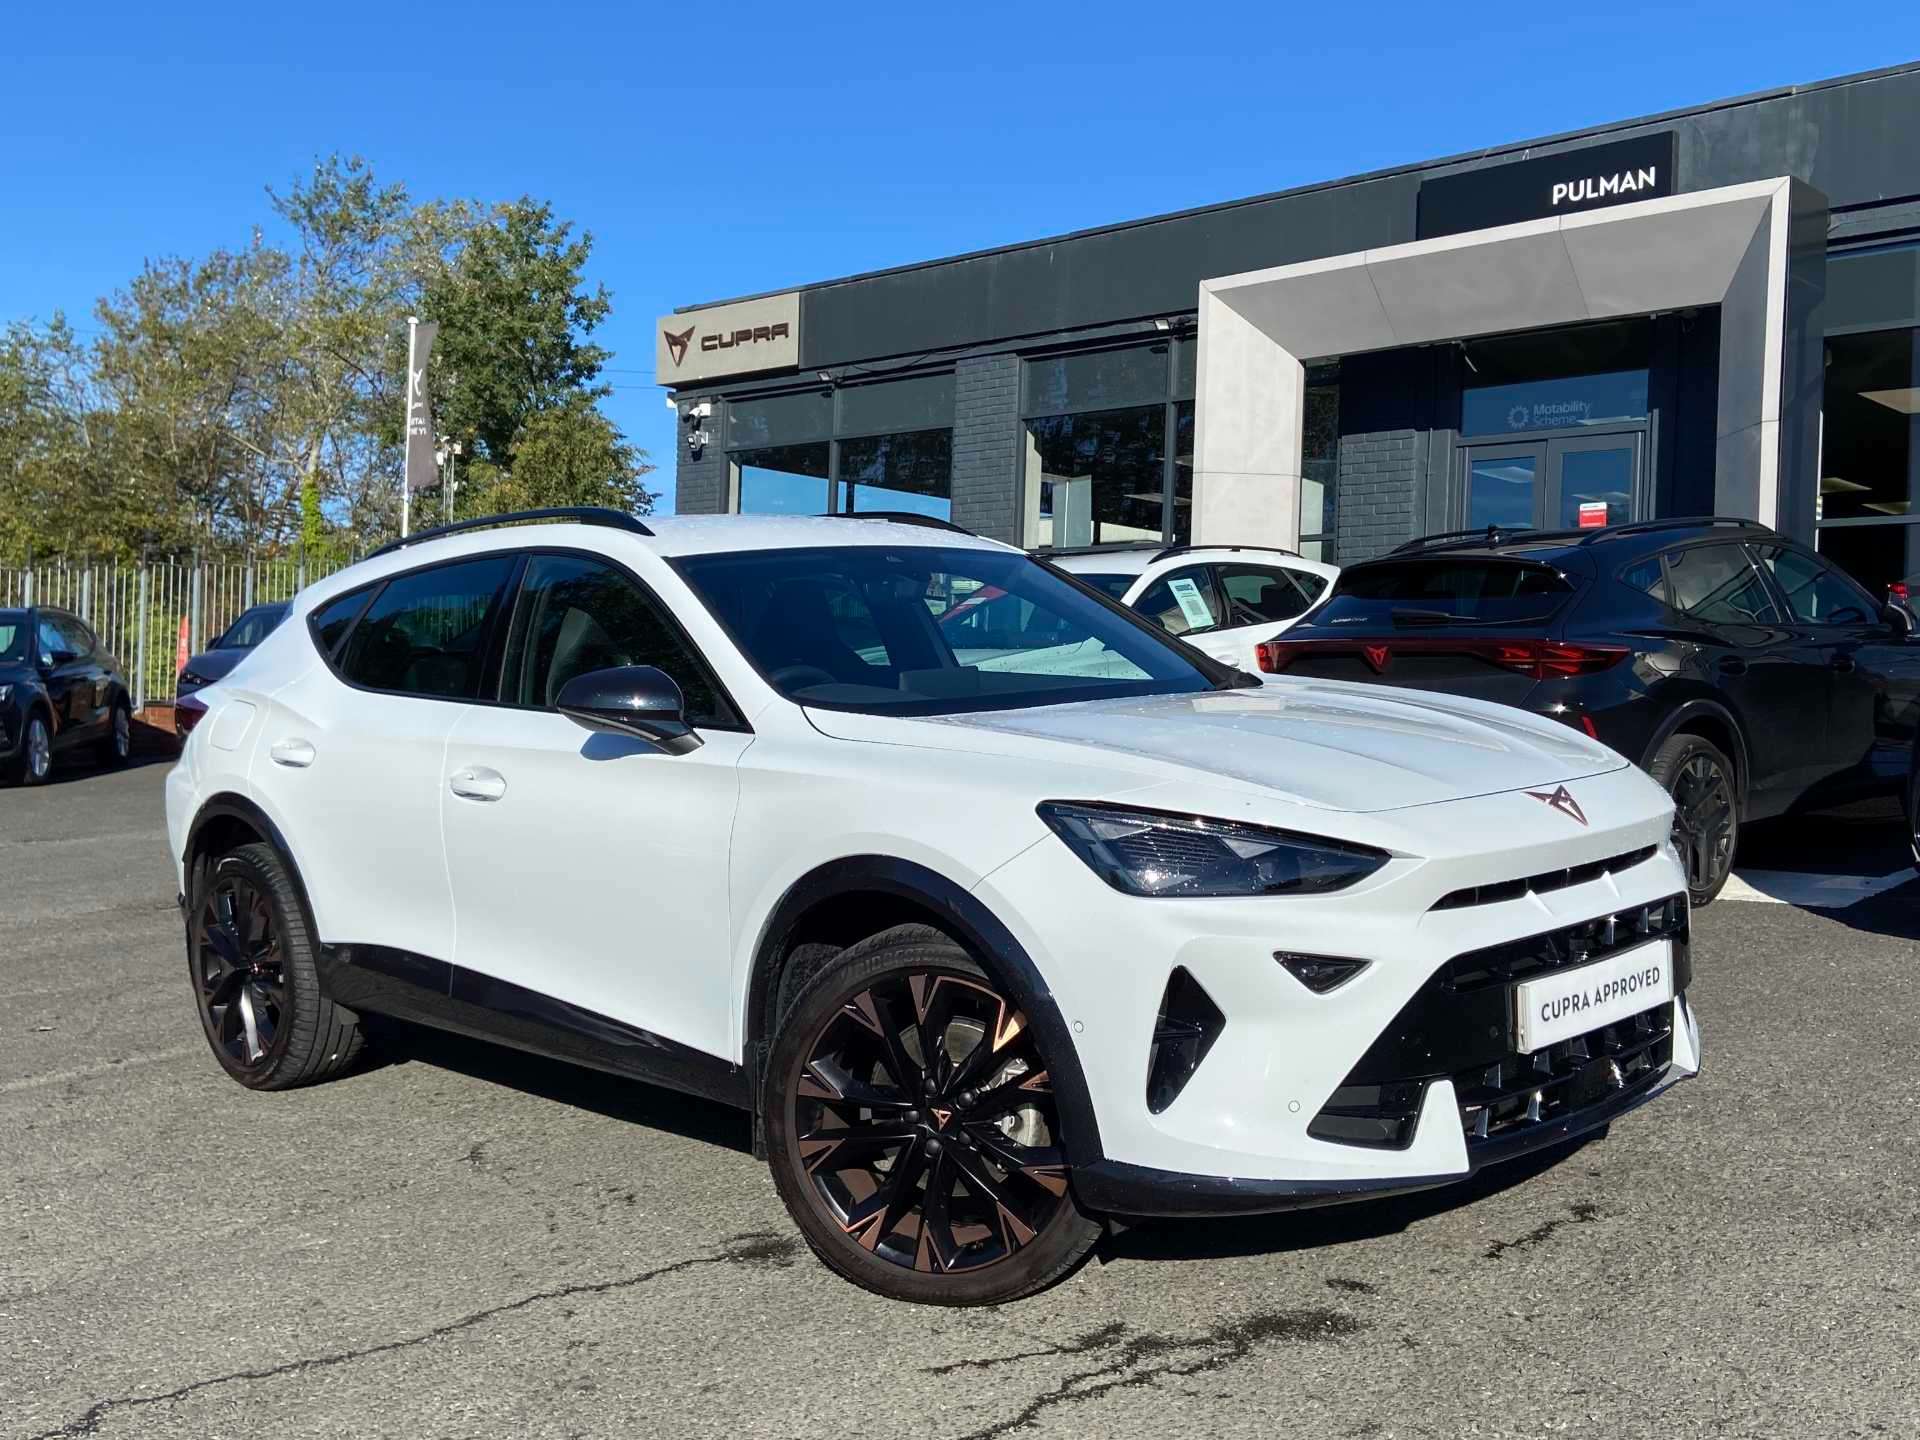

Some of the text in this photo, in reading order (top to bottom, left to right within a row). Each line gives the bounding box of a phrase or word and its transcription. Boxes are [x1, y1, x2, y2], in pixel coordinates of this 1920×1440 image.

[1552, 166, 1656, 205] PULMAN
[701, 322, 789, 351] CUPRA
[1533, 400, 1591, 420] Motability
[1534, 415, 1577, 427] Scheme
[1541, 967, 1660, 1022] CUPRA APPROVED
